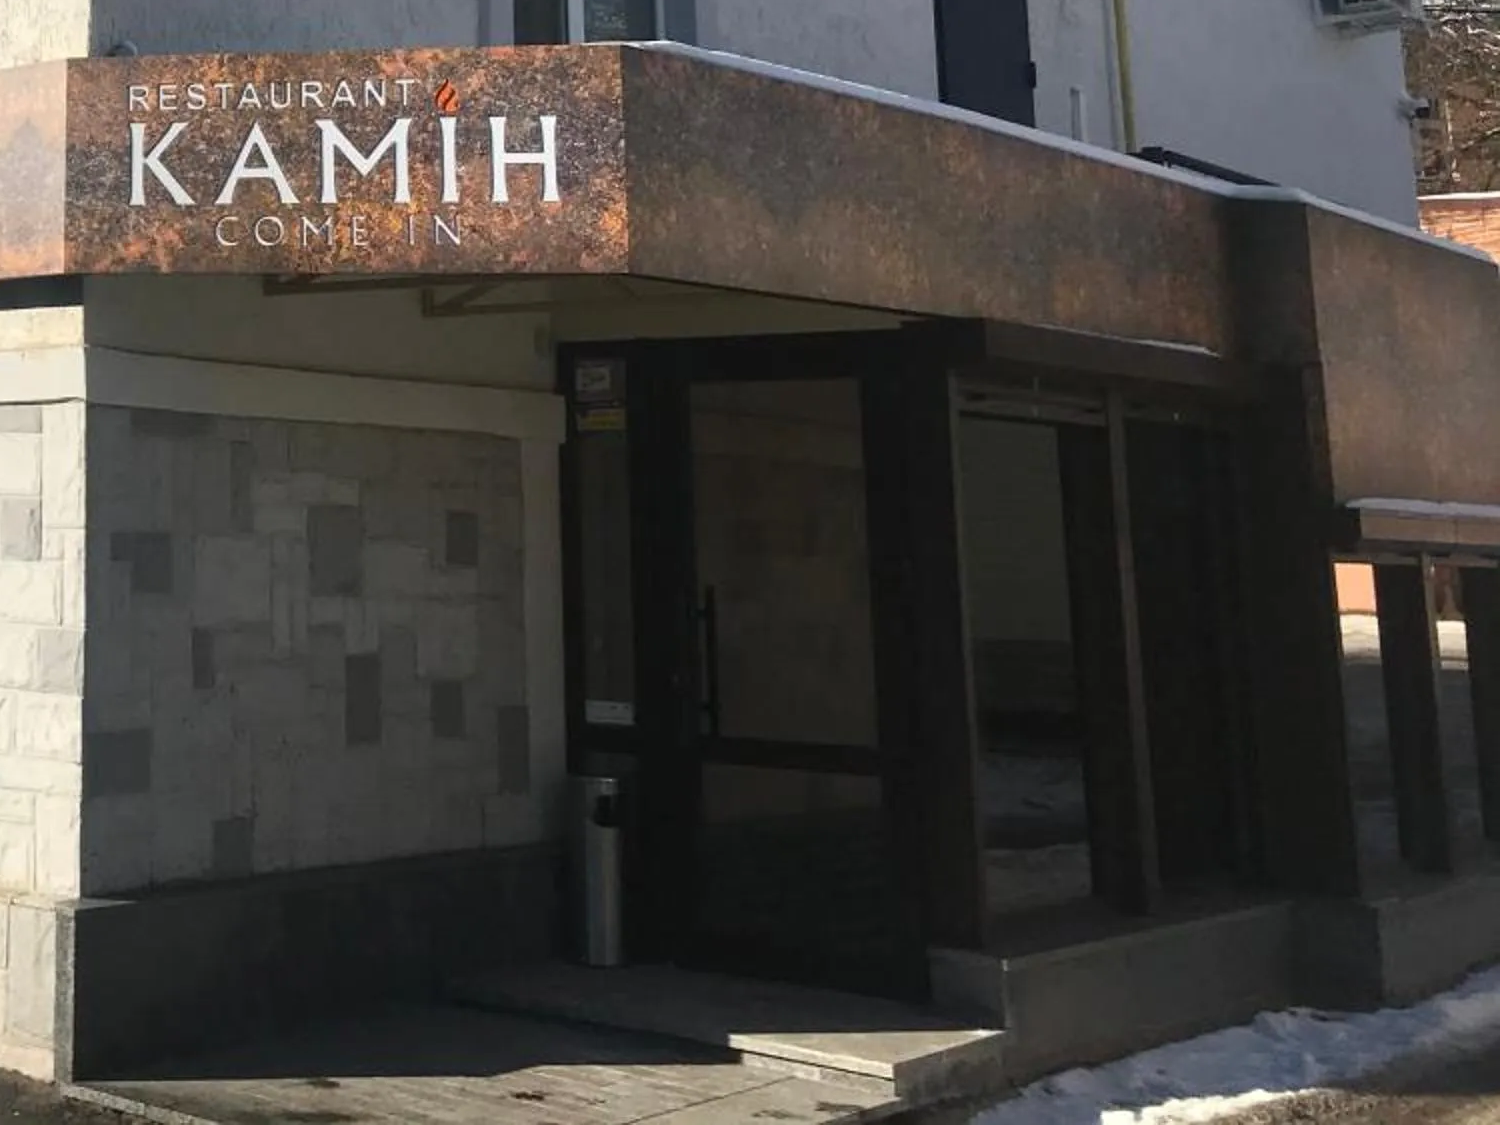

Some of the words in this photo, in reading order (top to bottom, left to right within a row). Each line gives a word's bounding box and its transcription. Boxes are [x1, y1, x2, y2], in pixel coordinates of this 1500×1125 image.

[128, 78, 416, 112] RESTAURANT
[215, 215, 369, 247] COME
[408, 215, 462, 246] IN
